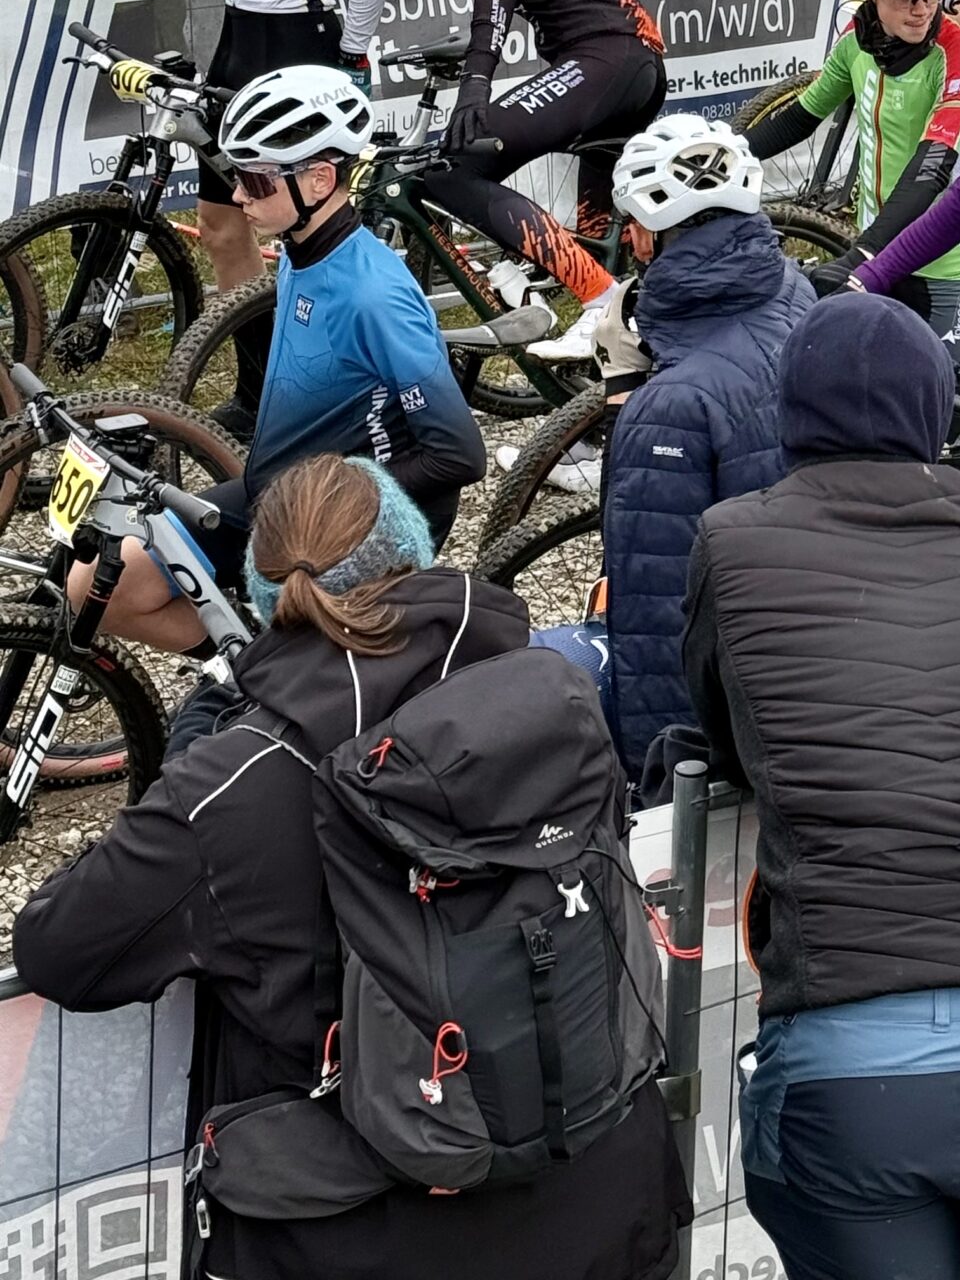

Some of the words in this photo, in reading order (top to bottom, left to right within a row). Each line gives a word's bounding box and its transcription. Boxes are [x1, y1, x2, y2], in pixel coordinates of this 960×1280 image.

[309, 86, 352, 109] KASK
[519, 80, 568, 115] MTB
[51, 458, 94, 525] 650
[535, 830, 574, 849] QUECHUA
